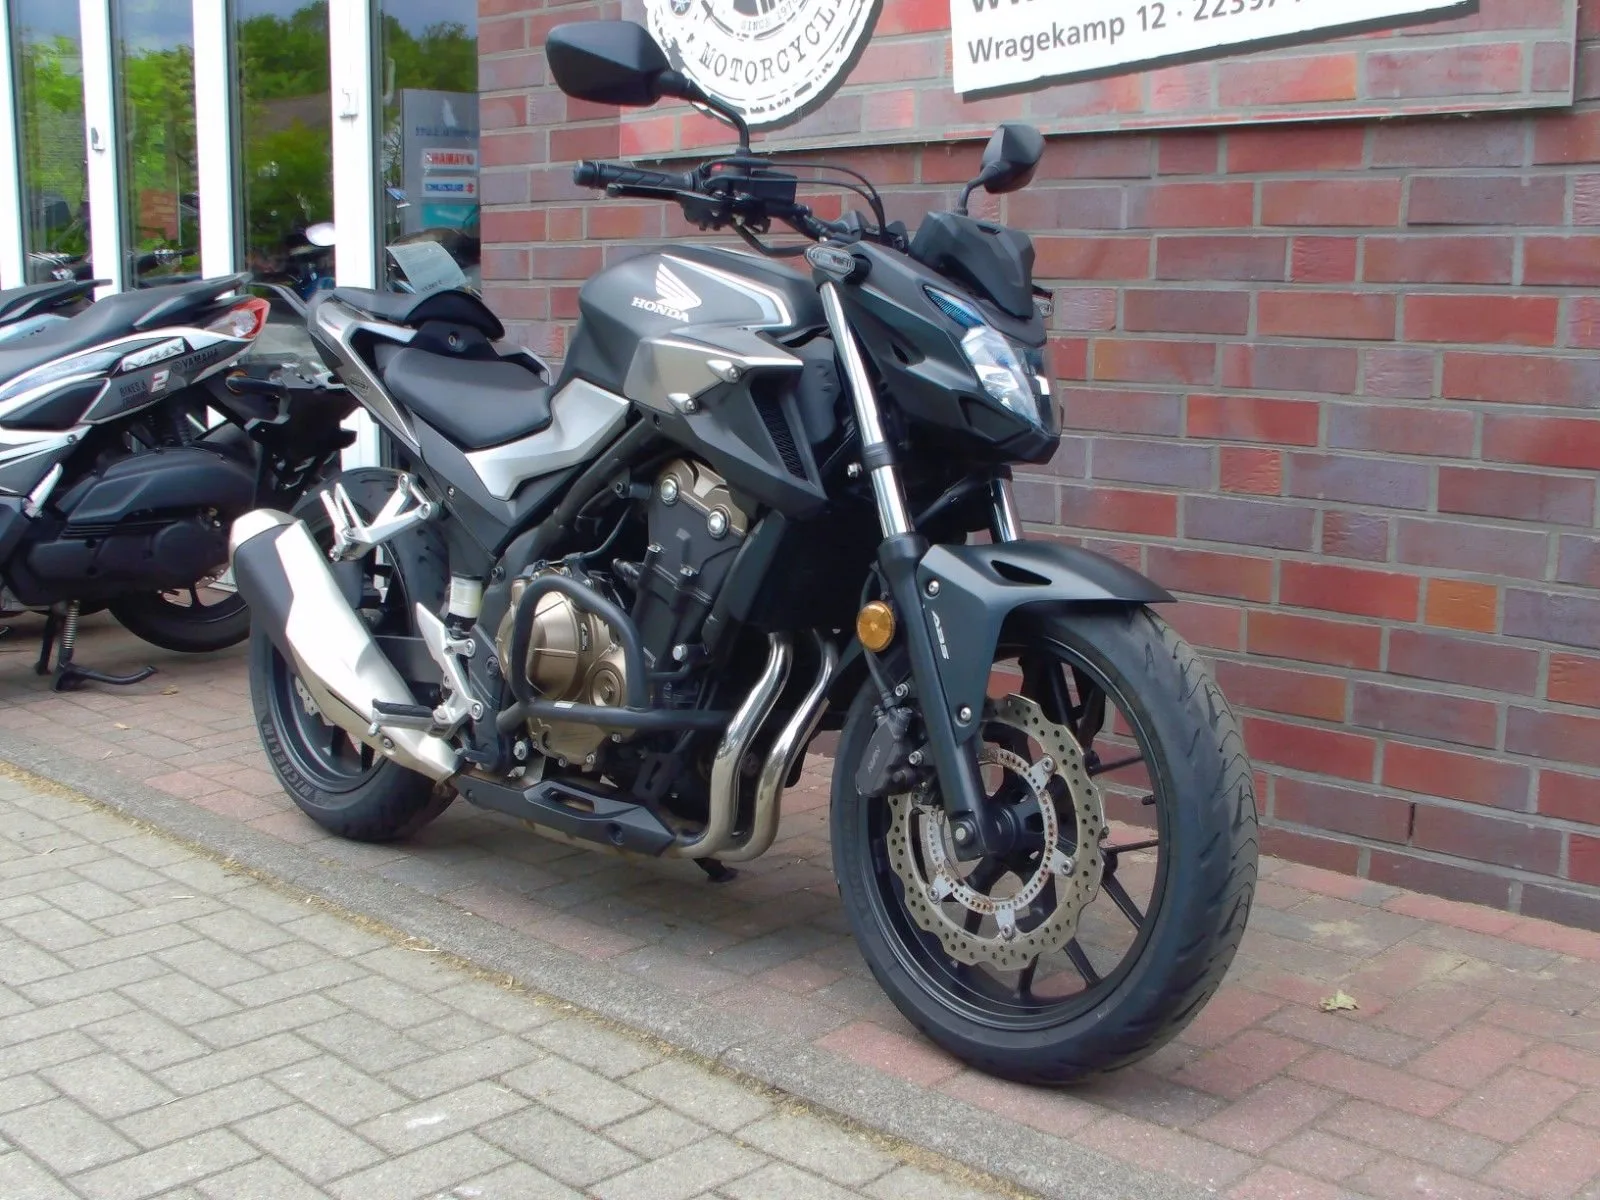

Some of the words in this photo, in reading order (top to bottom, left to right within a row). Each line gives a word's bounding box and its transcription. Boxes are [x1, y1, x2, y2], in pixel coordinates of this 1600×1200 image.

[699, 0, 841, 85] MOTORCYCL
[968, 16, 1125, 64] Wragekamp
[1136, 2, 1166, 32] 12
[631, 296, 690, 323] HONDA
[931, 610, 950, 660] ABS
[262, 722, 316, 800] MICHELIN
